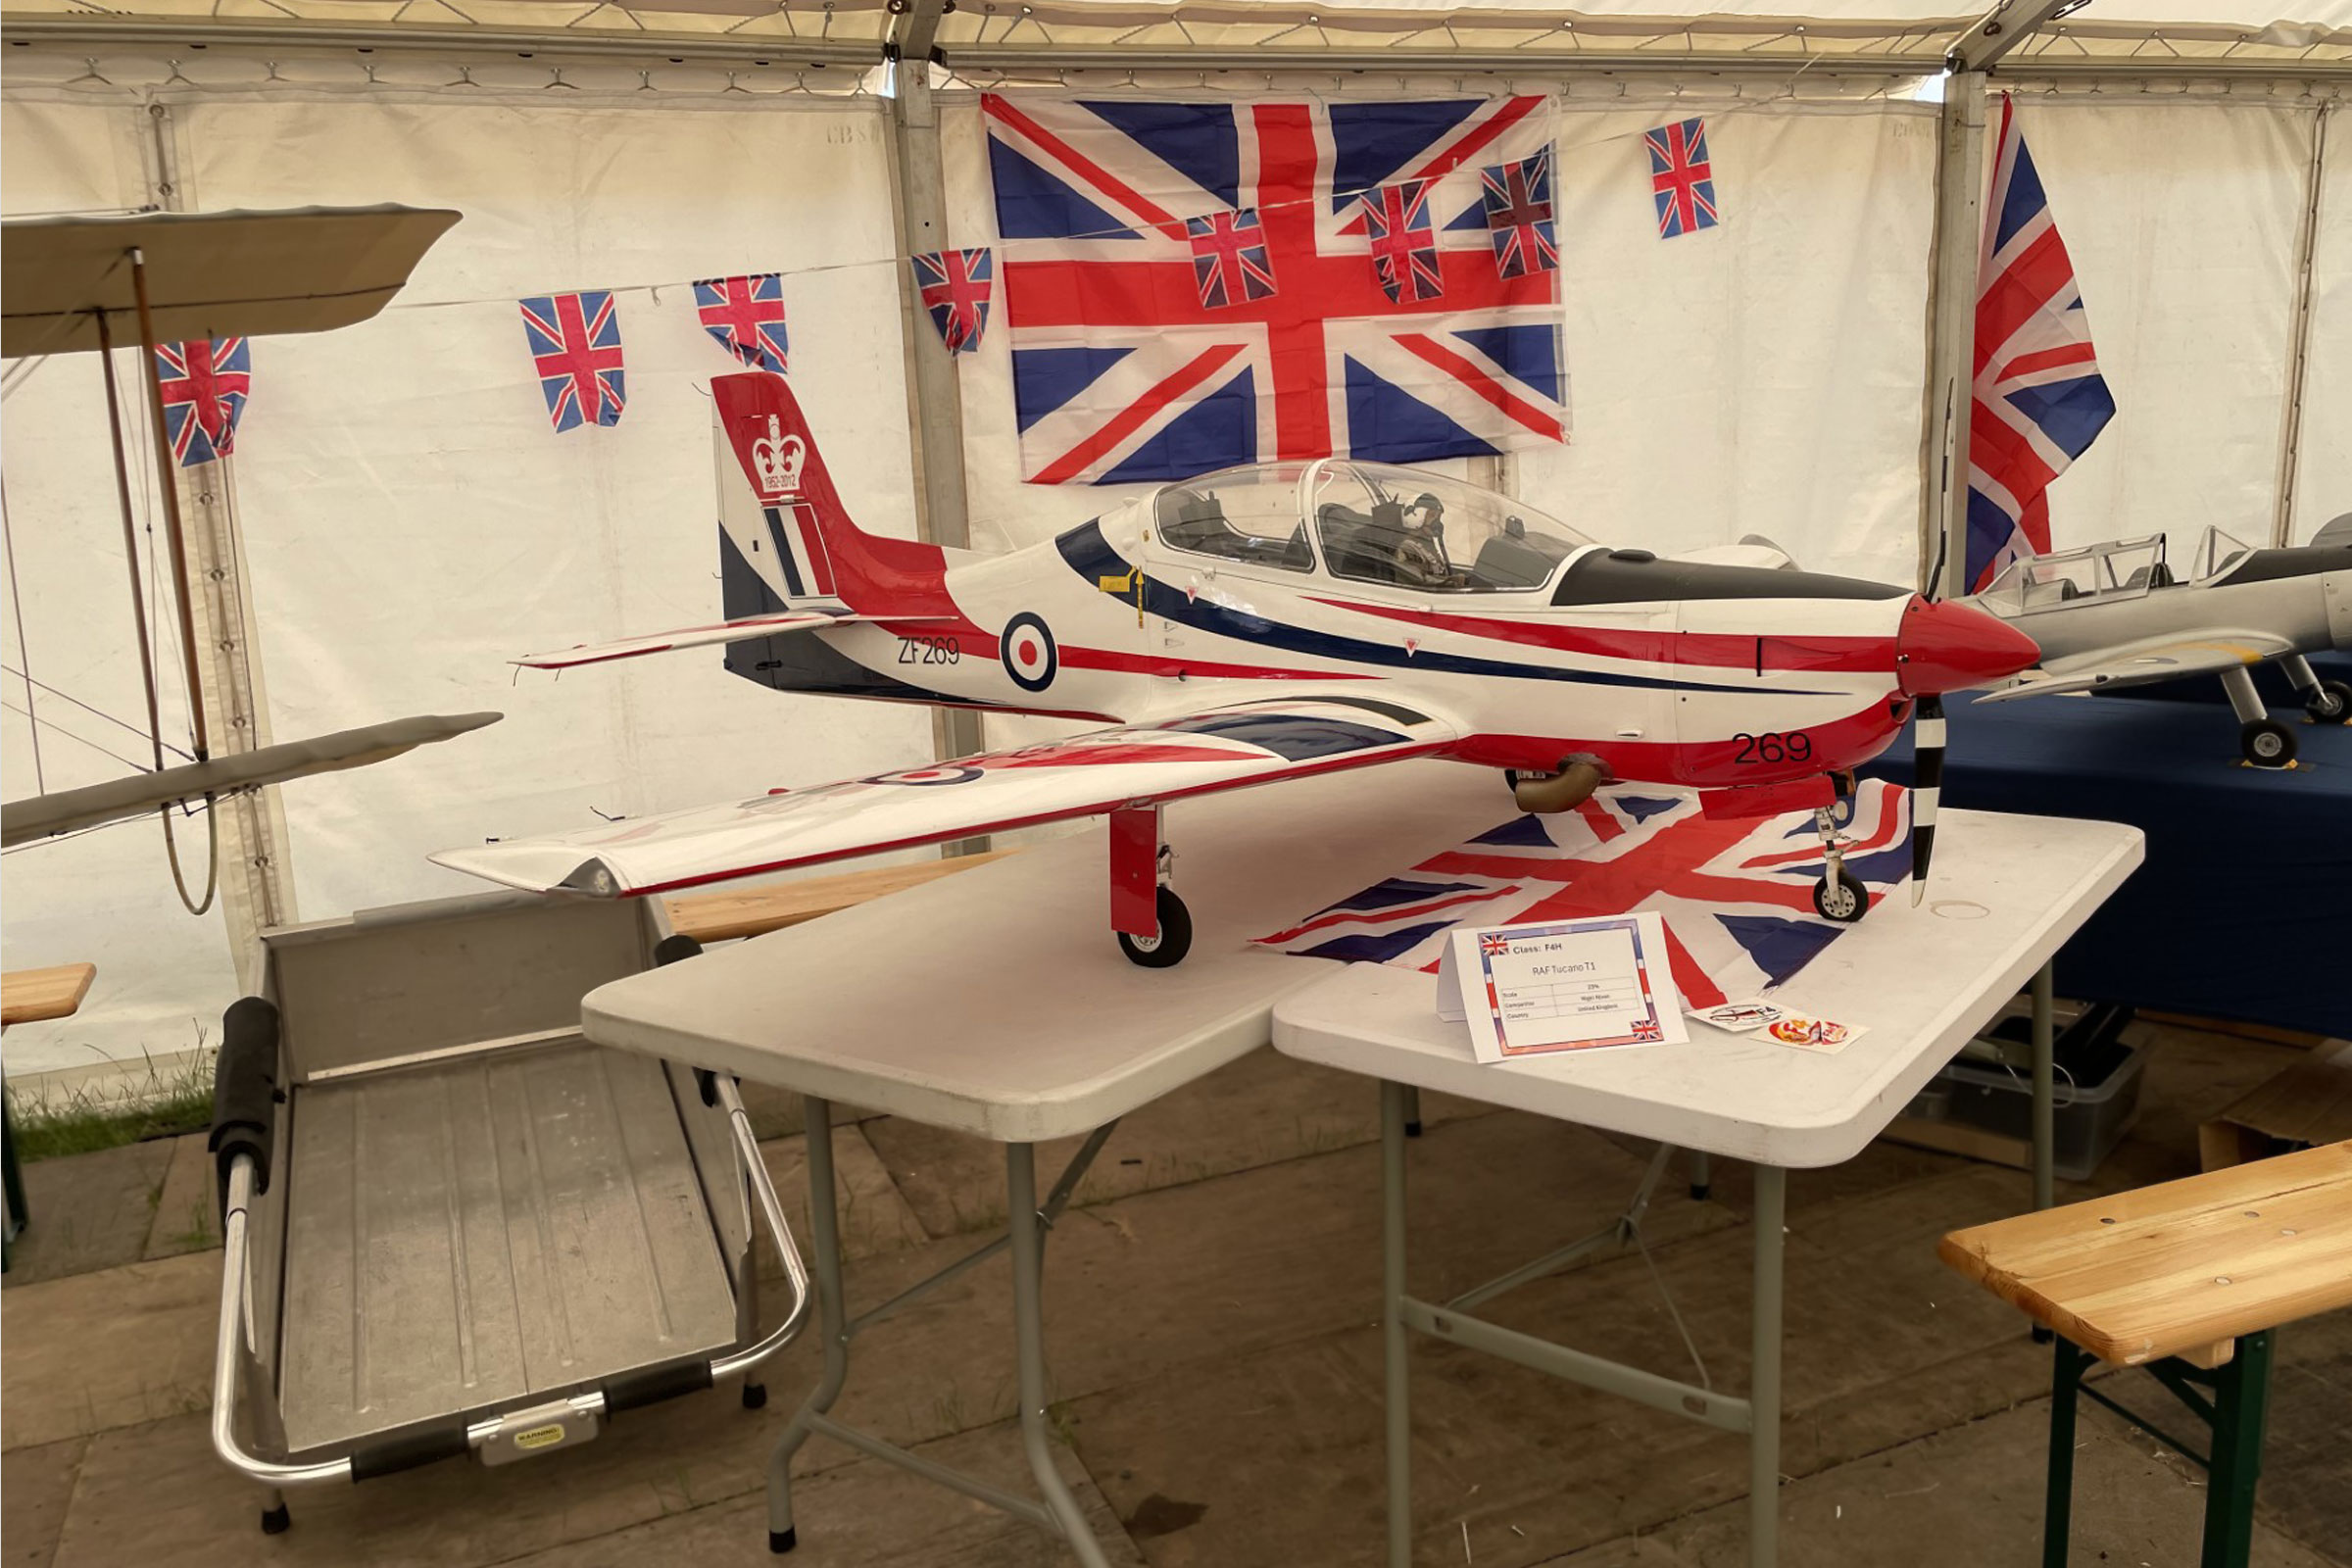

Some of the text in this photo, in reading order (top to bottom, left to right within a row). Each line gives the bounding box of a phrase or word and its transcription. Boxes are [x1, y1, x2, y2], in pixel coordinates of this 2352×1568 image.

[898, 637, 959, 664] ZF269
[1732, 732, 1811, 763] 269
[1513, 946, 1541, 955] Class:
[1533, 961, 1596, 976] RAF Tucano T1
